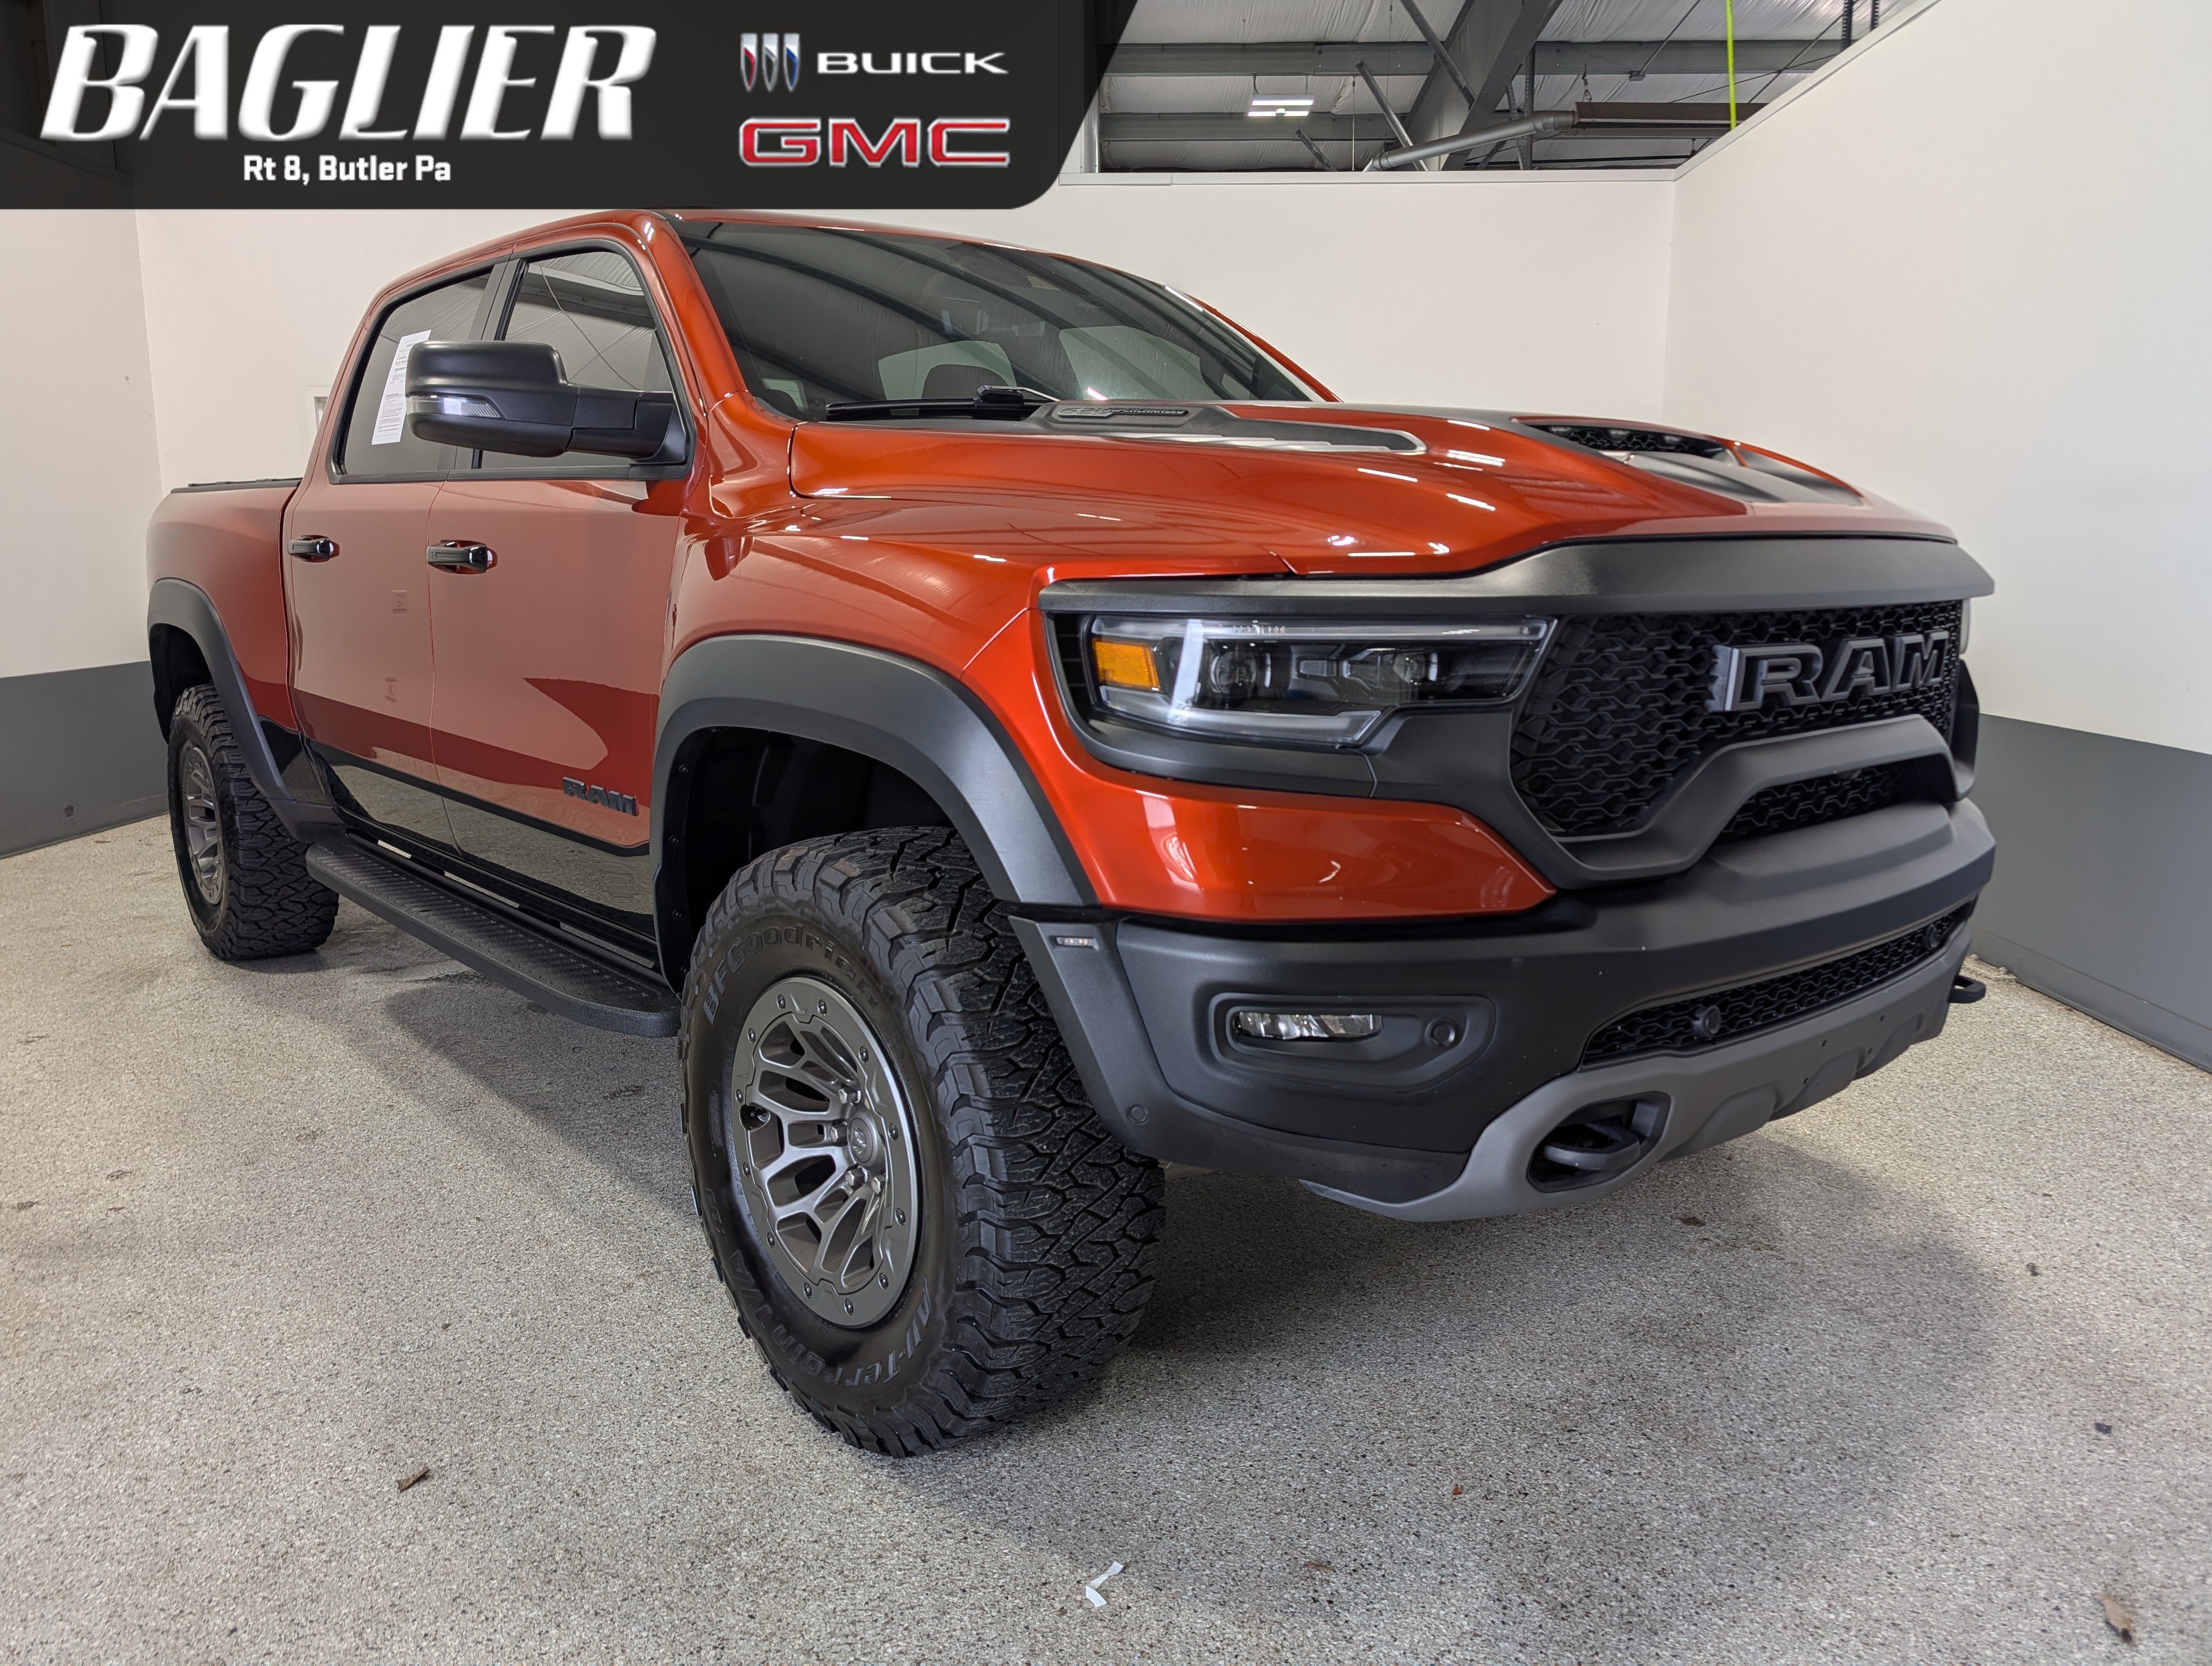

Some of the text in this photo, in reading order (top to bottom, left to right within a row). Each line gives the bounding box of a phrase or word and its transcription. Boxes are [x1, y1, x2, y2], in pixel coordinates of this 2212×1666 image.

[1709, 630, 1950, 712] RAM
[562, 777, 640, 816] RAM
[703, 923, 878, 1027] BFGoodrich
[772, 1277, 931, 1387] All-Terrain
